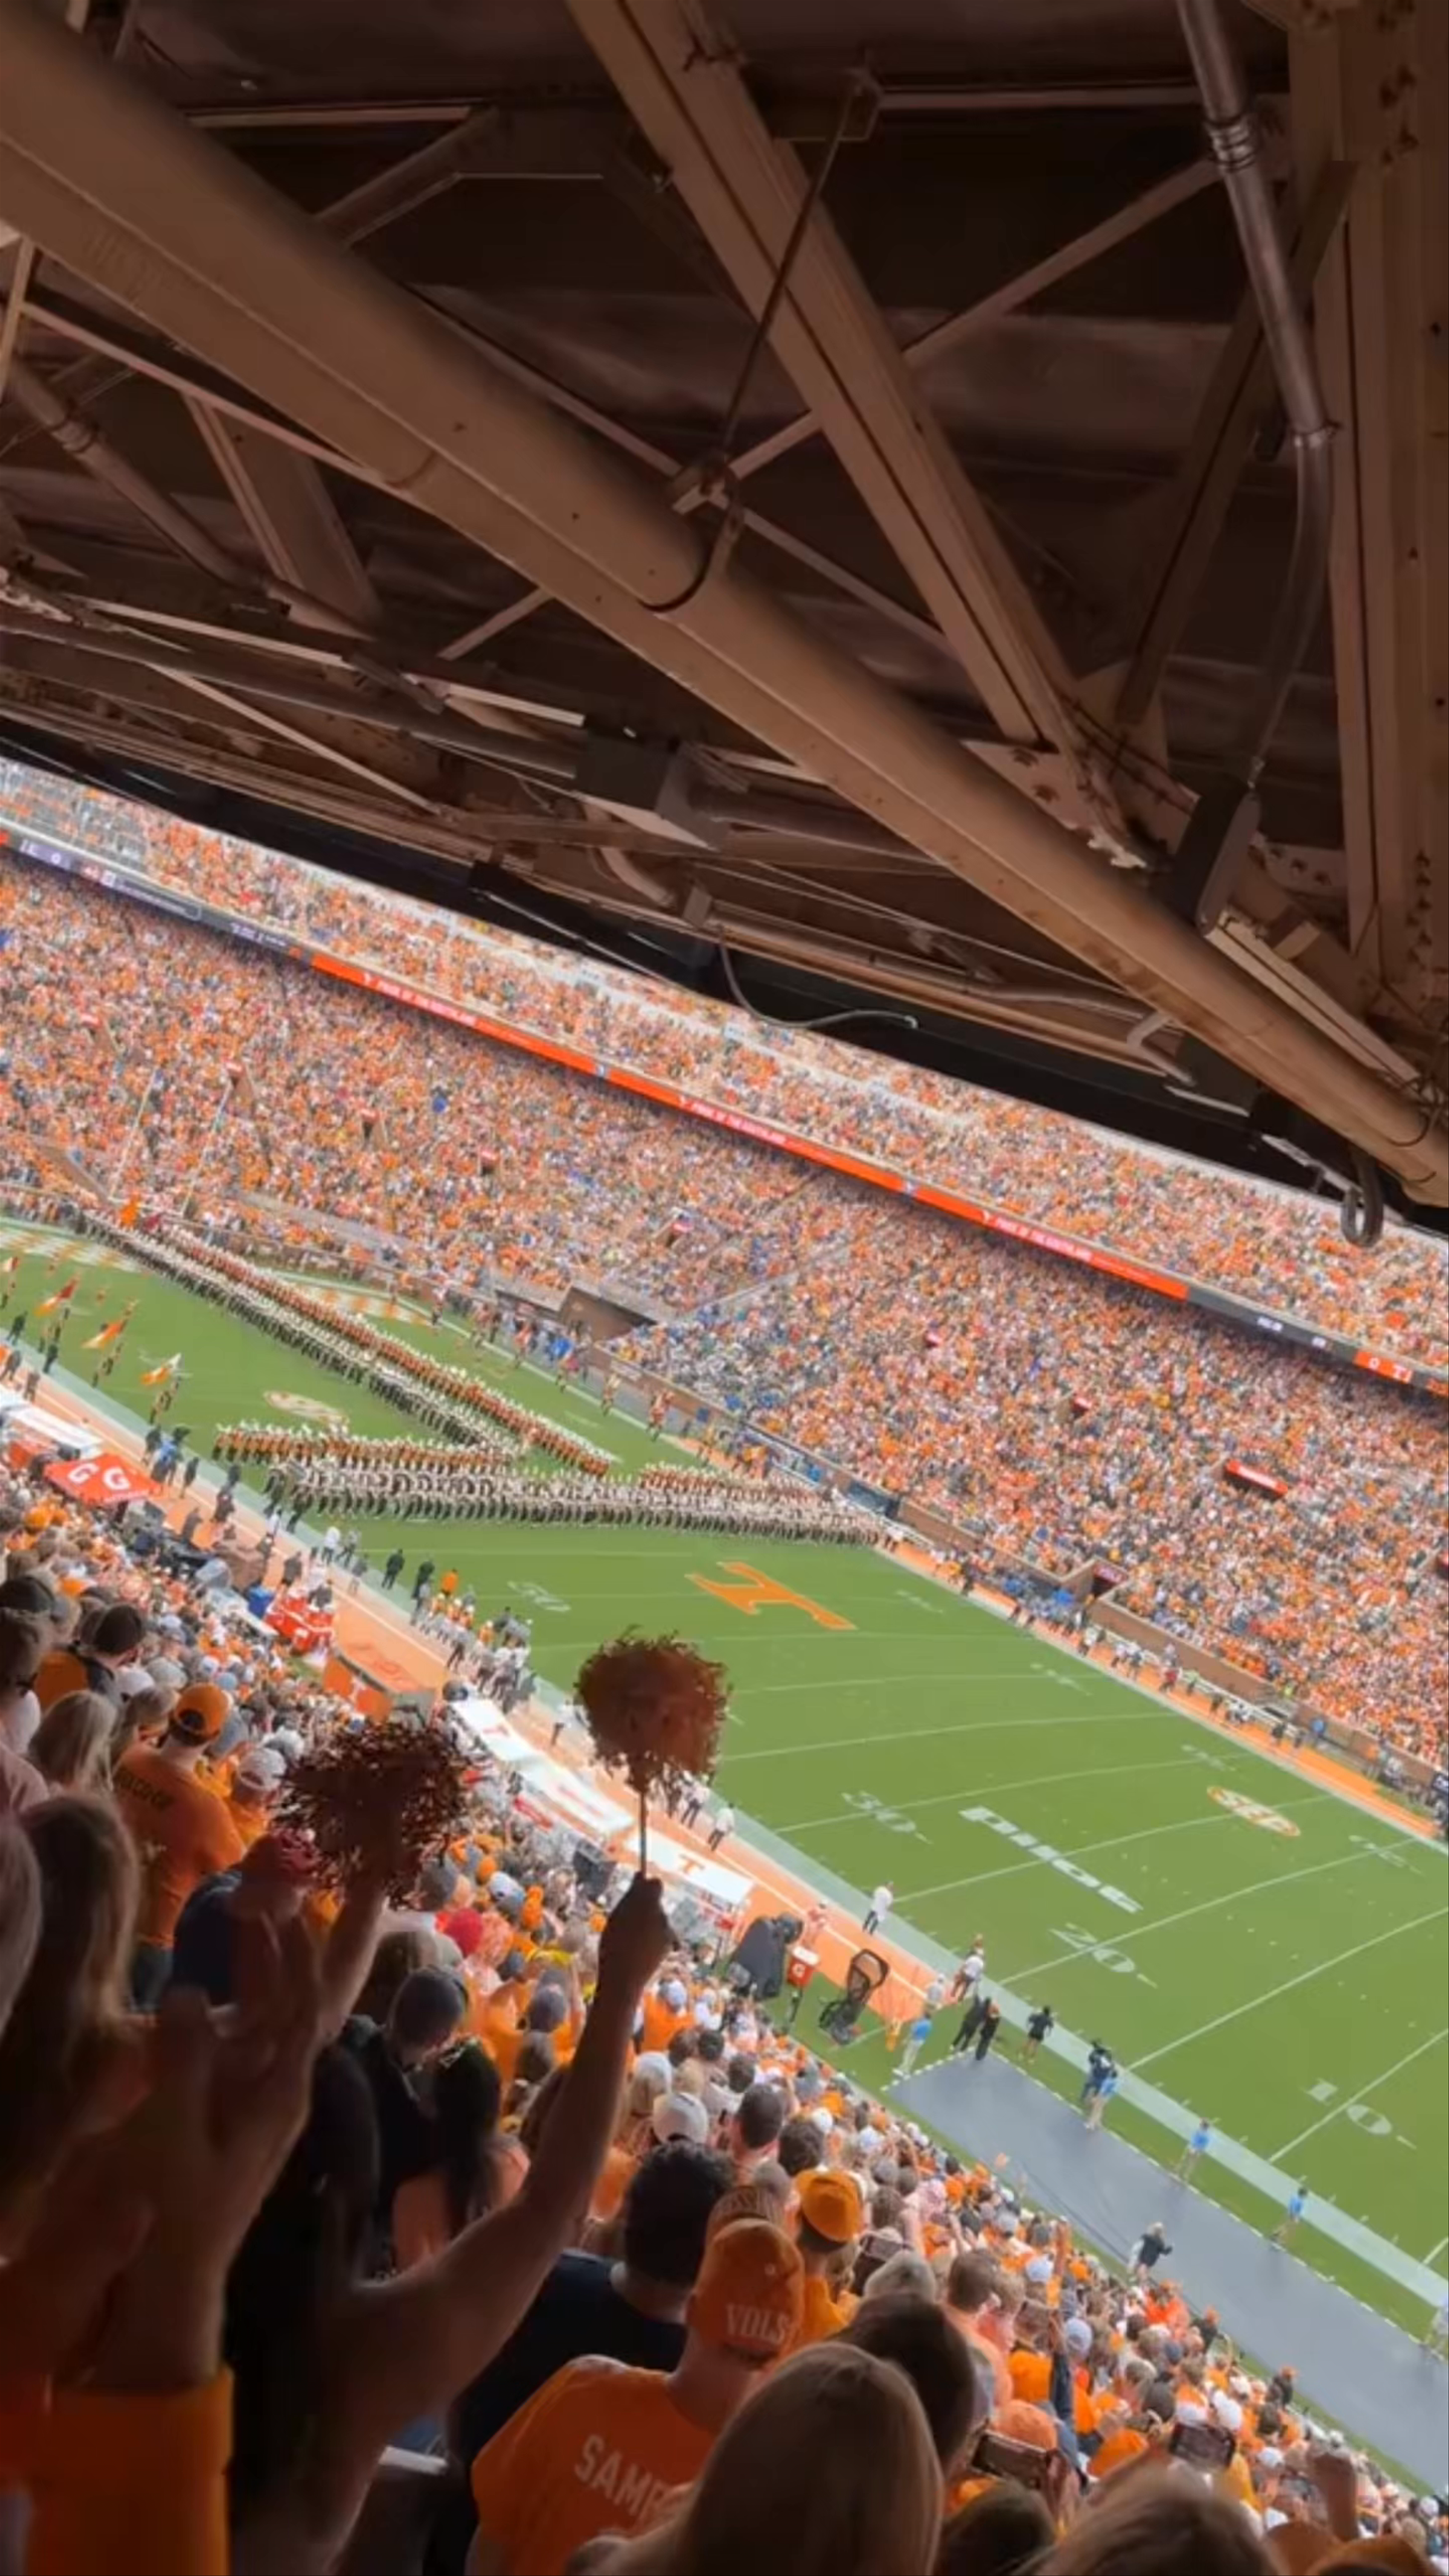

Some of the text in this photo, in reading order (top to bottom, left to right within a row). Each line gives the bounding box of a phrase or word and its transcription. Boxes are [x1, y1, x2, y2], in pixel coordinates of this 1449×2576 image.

[68, 1463, 99, 1483] G
[103, 1467, 131, 1490] G
[684, 1561, 858, 1631] T
[1048, 1922, 1135, 1972] 20
[1302, 2077, 1392, 2135] 10
[726, 2304, 789, 2345] VOLS
